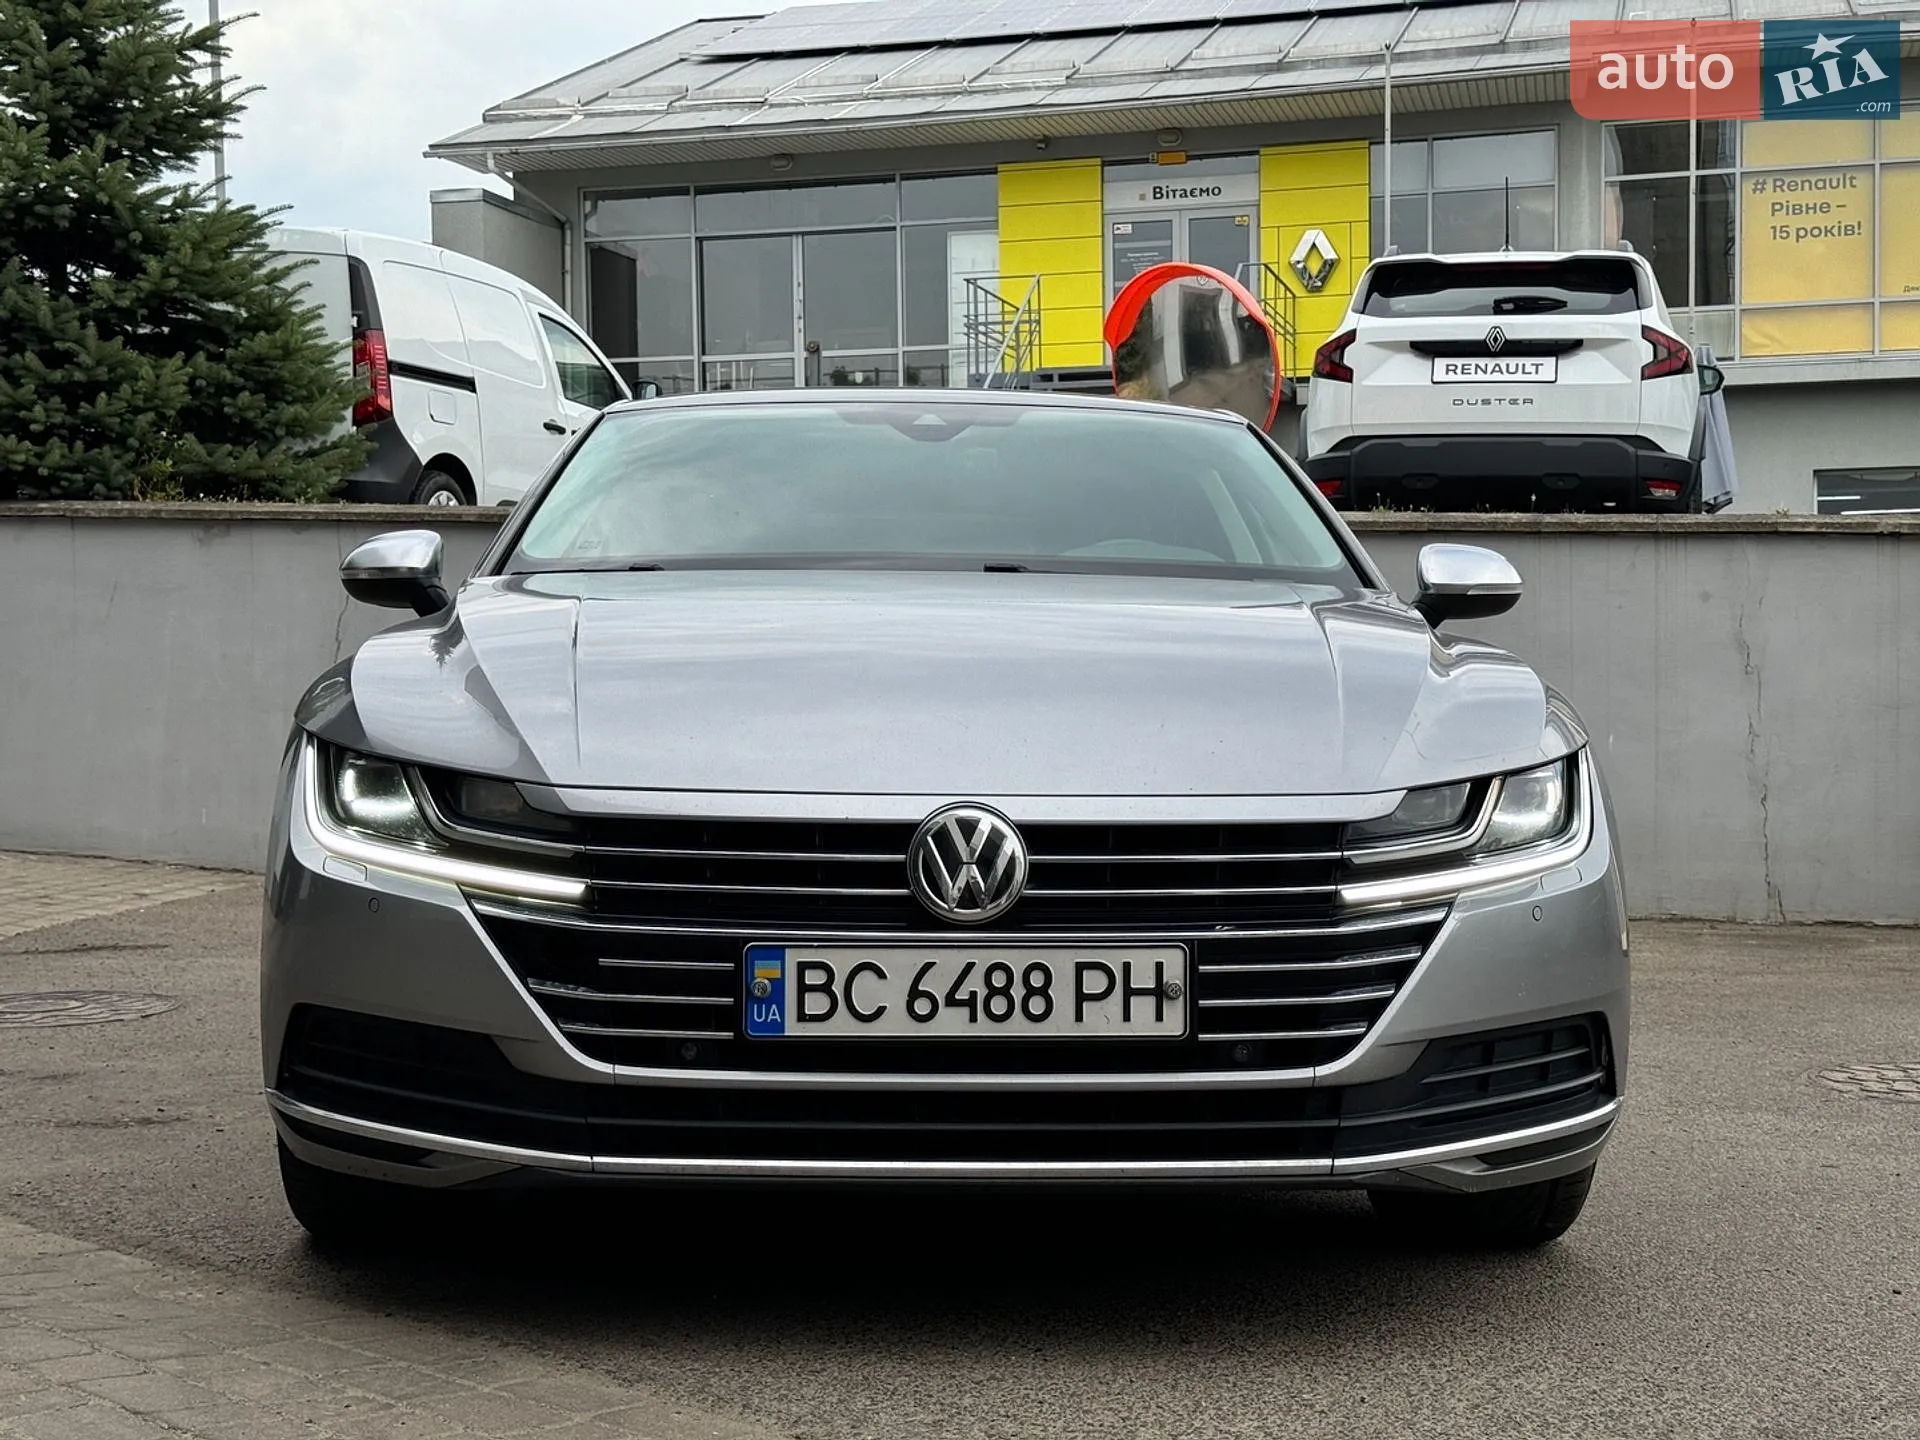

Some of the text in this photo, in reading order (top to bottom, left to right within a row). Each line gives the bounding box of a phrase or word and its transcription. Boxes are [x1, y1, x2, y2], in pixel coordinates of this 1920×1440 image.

[1152, 184, 1222, 200] Вітаємо
[1770, 221, 1862, 243] 15 років!
[1445, 362, 1544, 376] RENAULT
[1452, 398, 1534, 406] DUSTER
[796, 960, 1165, 1024] BC 6488 PH
[754, 1004, 781, 1022] UA
